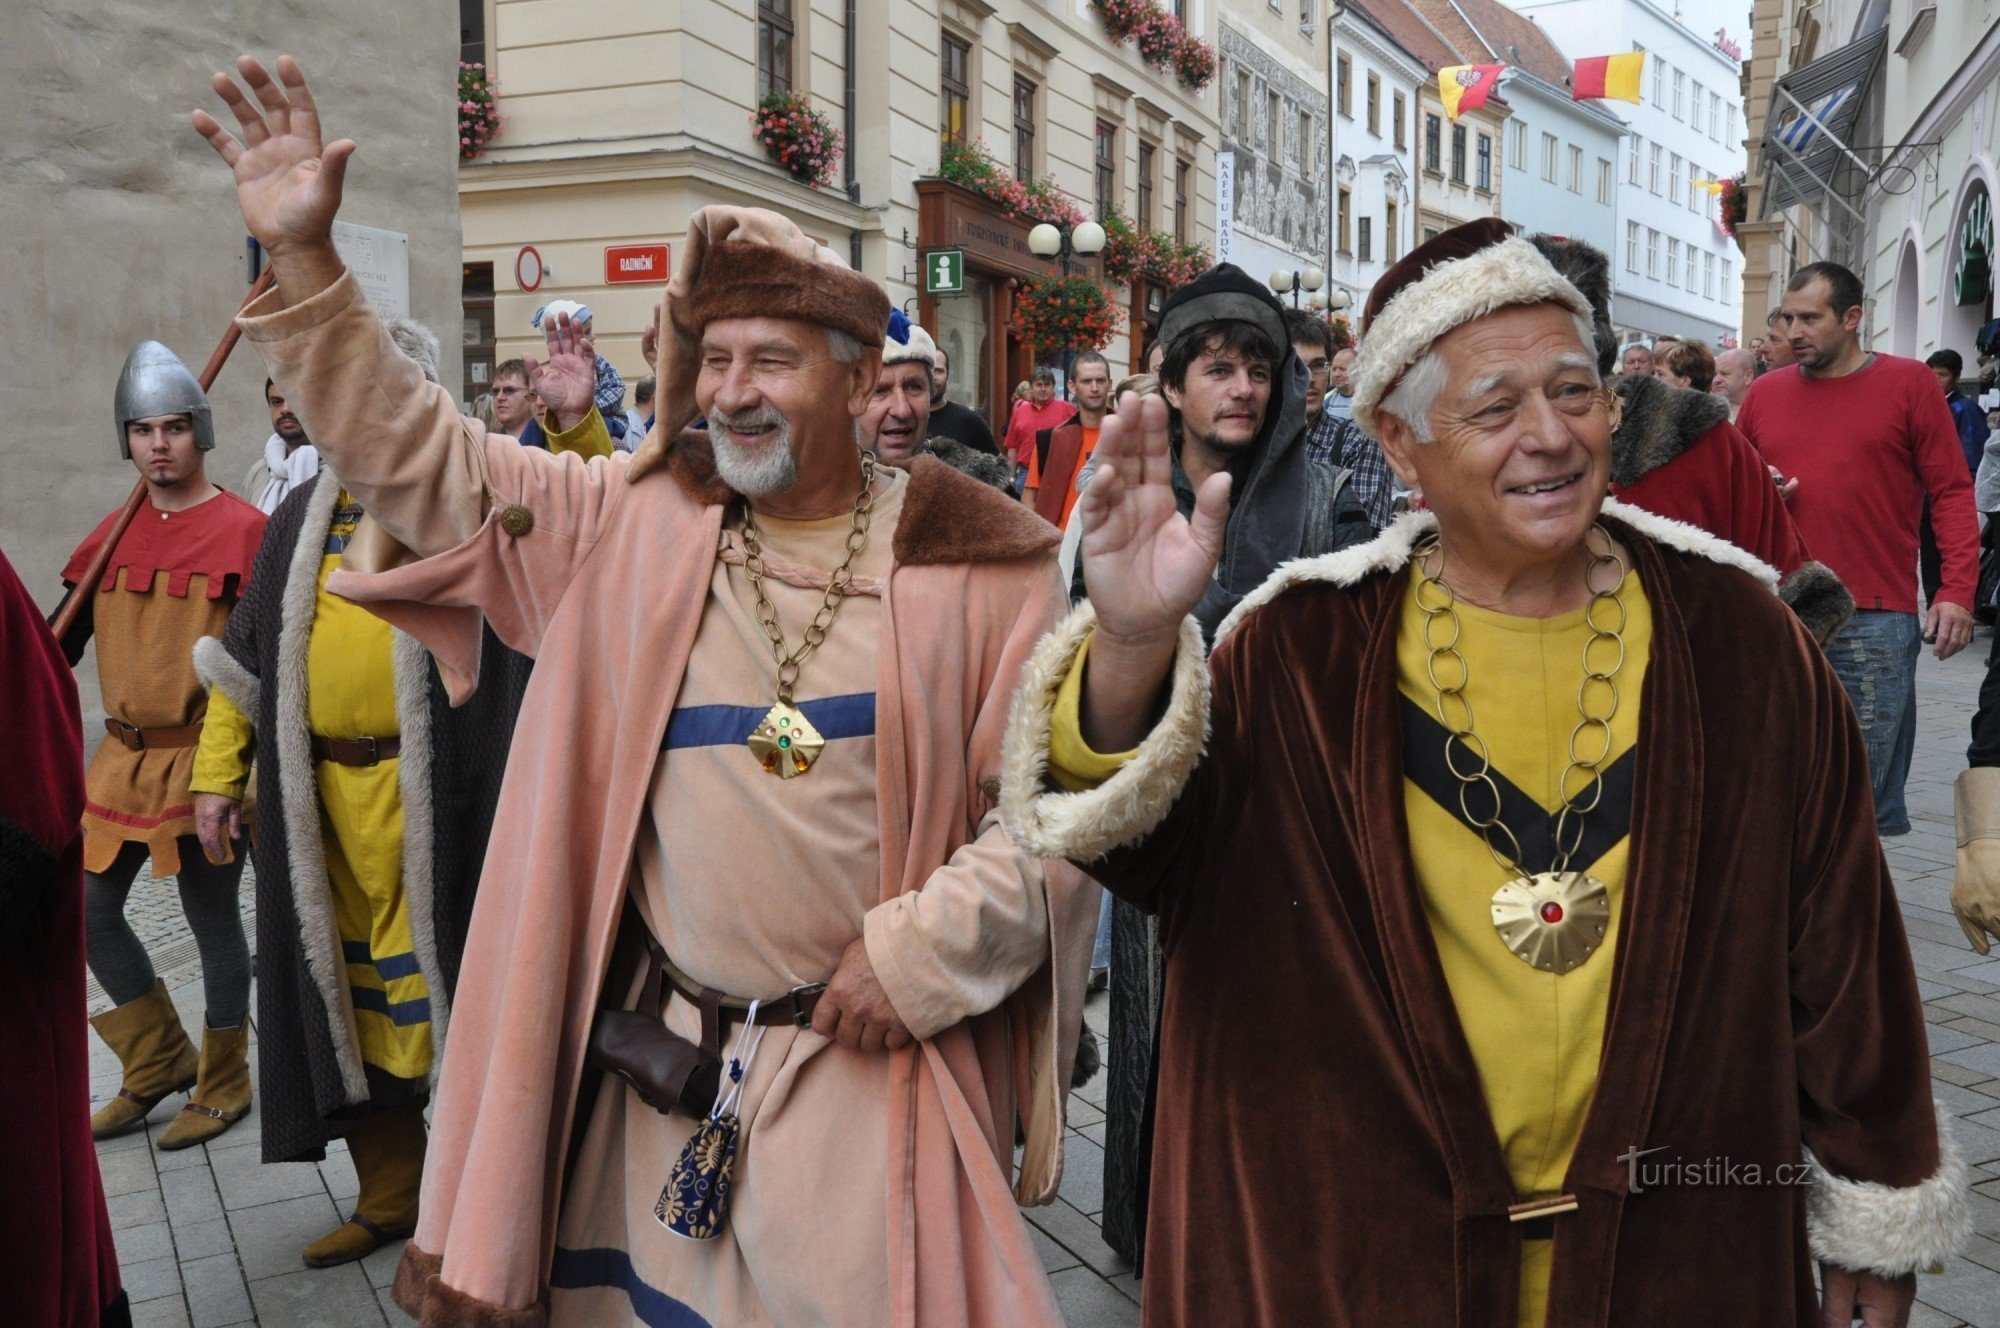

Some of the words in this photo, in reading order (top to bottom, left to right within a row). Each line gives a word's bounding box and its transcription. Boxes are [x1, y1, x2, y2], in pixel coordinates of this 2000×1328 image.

[1221, 161, 1229, 198] KAFE
[1221, 203, 1229, 211] U
[619, 254, 653, 271] RADNIČNÍ
